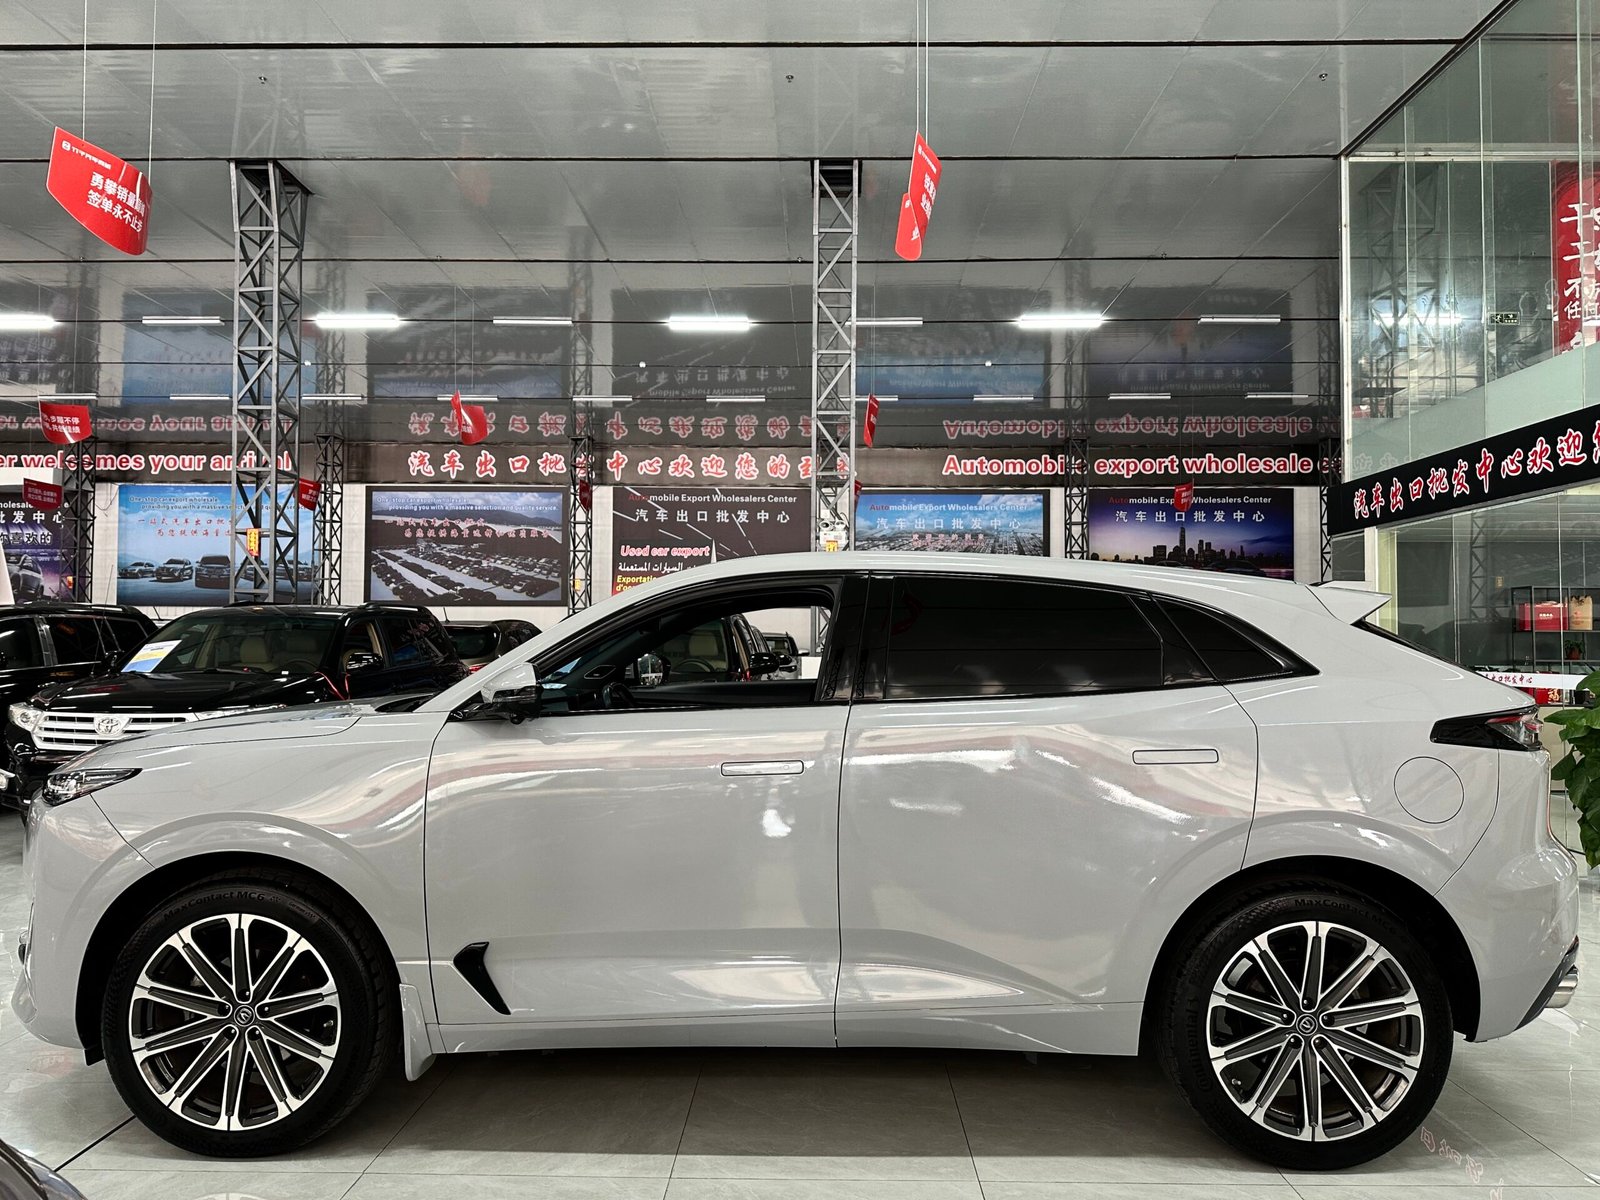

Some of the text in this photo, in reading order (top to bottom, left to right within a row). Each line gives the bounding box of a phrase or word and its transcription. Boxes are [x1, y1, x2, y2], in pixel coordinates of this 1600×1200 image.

[149, 453, 207, 475] your
[1094, 455, 1179, 478] export
[1183, 453, 1313, 474] wholesale
[1353, 419, 1600, 520] 汽车出口批发中心欢迎
[681, 494, 713, 504] Export
[714, 493, 766, 503] Wholesalers
[767, 494, 797, 503] Center
[1243, 496, 1272, 504] Center
[869, 503, 918, 511] Automobile
[919, 503, 946, 512] Export
[635, 508, 790, 523] 汽车出口批发中心
[1115, 510, 1265, 523] 汽车出口批发中心
[876, 517, 1021, 530] 汽车出口批发中心
[620, 545, 711, 558] Used car export
